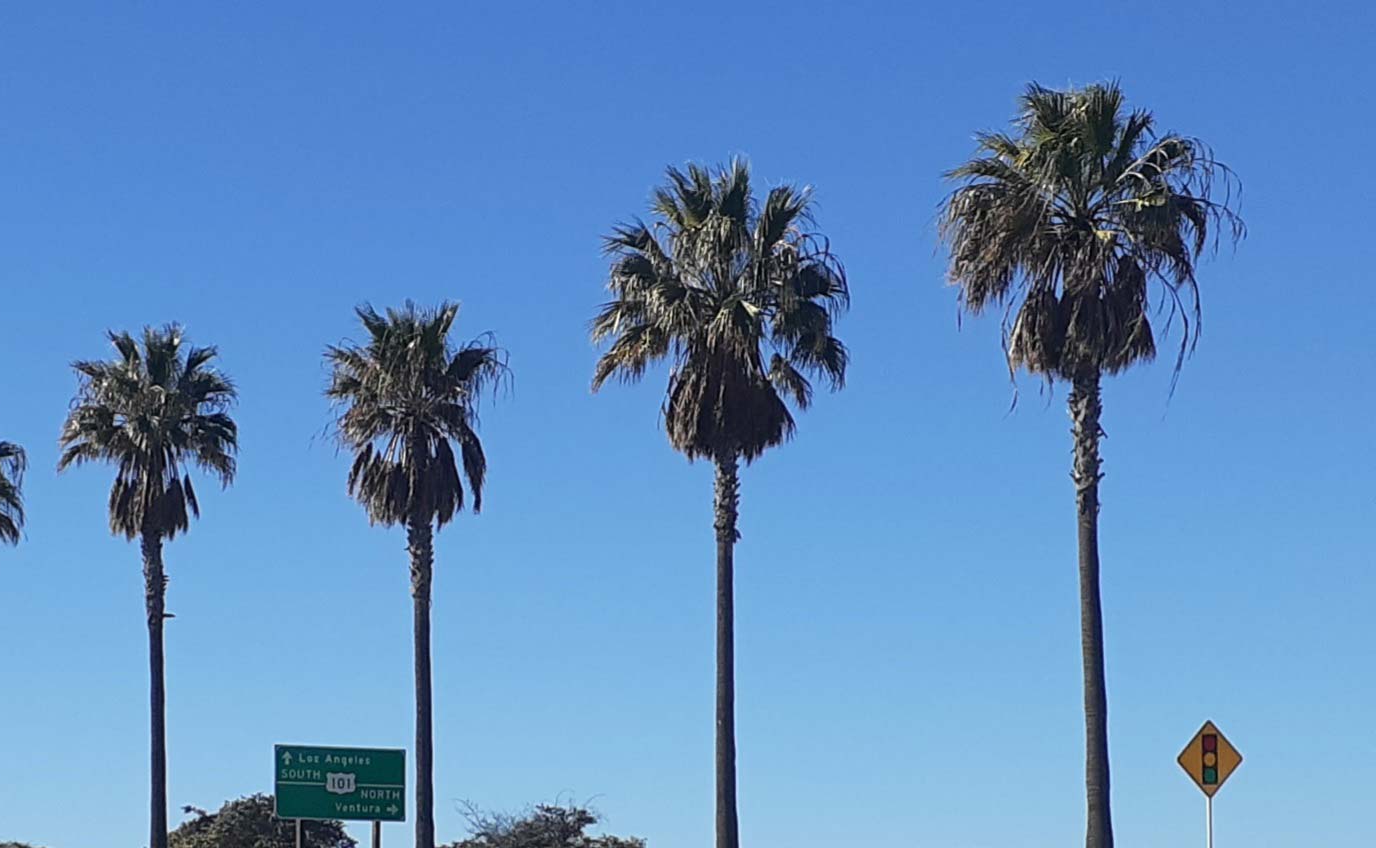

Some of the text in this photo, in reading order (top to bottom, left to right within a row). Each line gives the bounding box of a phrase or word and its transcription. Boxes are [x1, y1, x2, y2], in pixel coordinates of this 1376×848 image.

[298, 753, 371, 767] Los Angeles
[281, 769, 321, 779] SOUTH
[331, 778, 351, 789] 101
[360, 789, 401, 800] NORTH
[335, 802, 381, 813] Ventura
